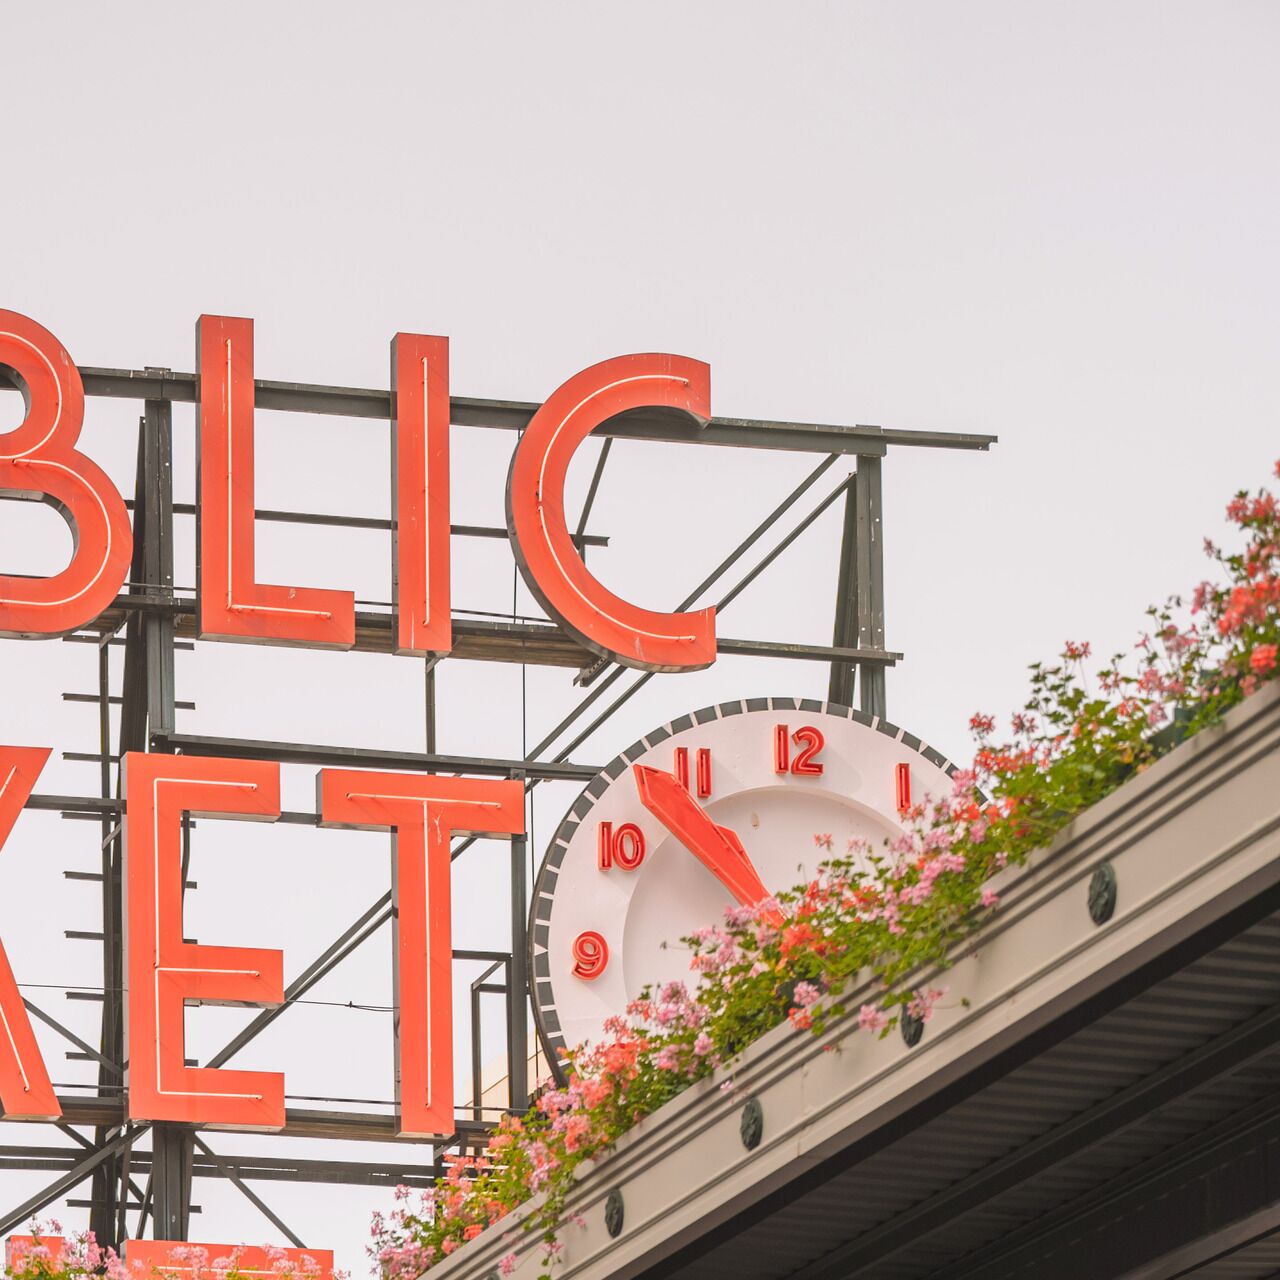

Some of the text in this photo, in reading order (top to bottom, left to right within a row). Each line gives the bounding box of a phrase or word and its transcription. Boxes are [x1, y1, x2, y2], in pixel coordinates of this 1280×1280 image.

[674, 747, 712, 798] 11
[774, 724, 825, 776] 12
[895, 763, 911, 811] 1
[598, 822, 647, 872] 10
[571, 930, 610, 982] 9
